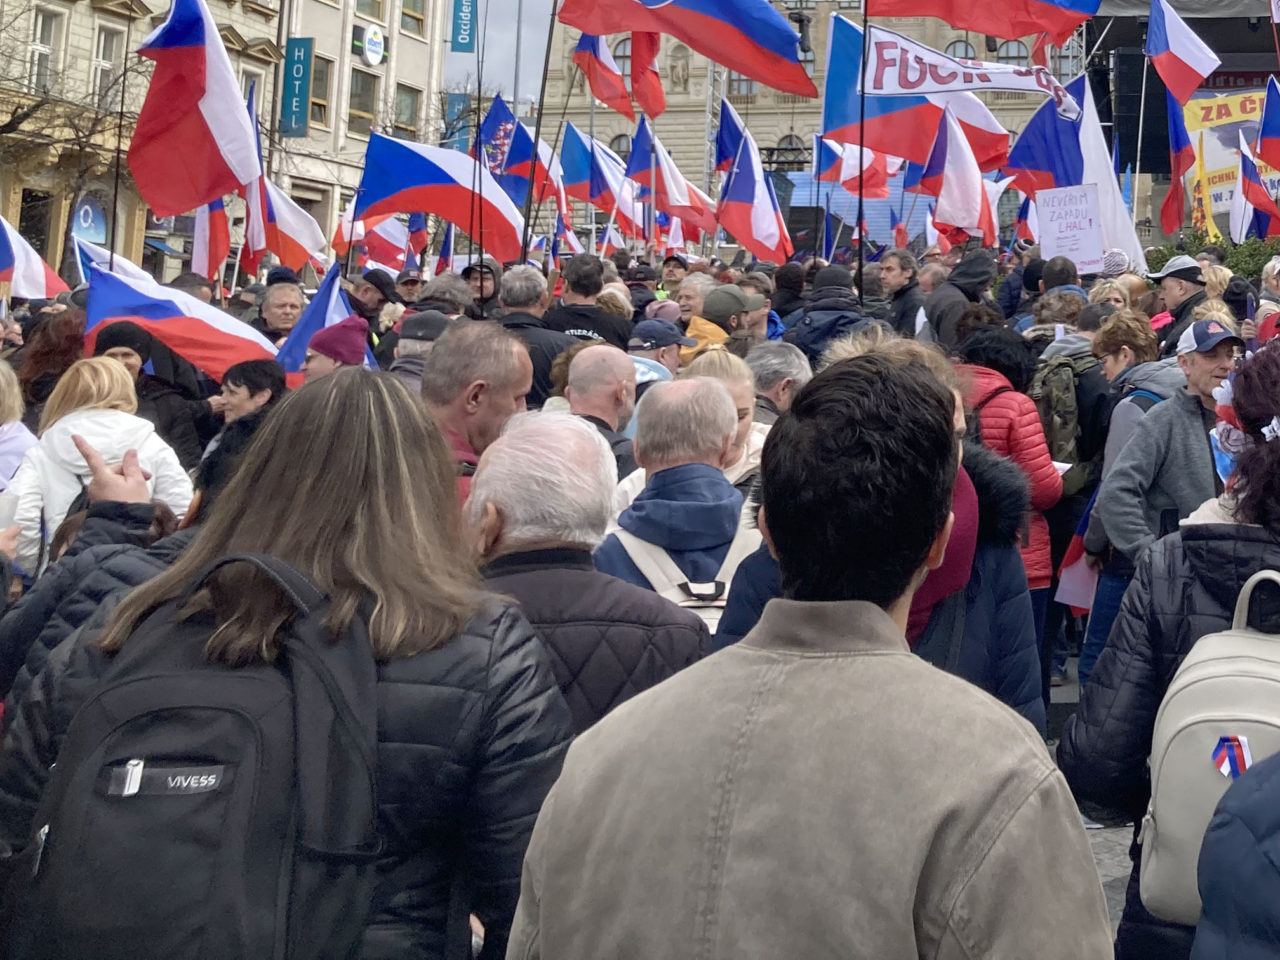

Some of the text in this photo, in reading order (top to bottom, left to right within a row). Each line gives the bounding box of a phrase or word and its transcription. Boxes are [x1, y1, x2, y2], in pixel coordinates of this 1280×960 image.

[291, 47, 305, 128] HOTEL
[1200, 103, 1232, 122] ZA
[166, 774, 217, 789] VIVESS
